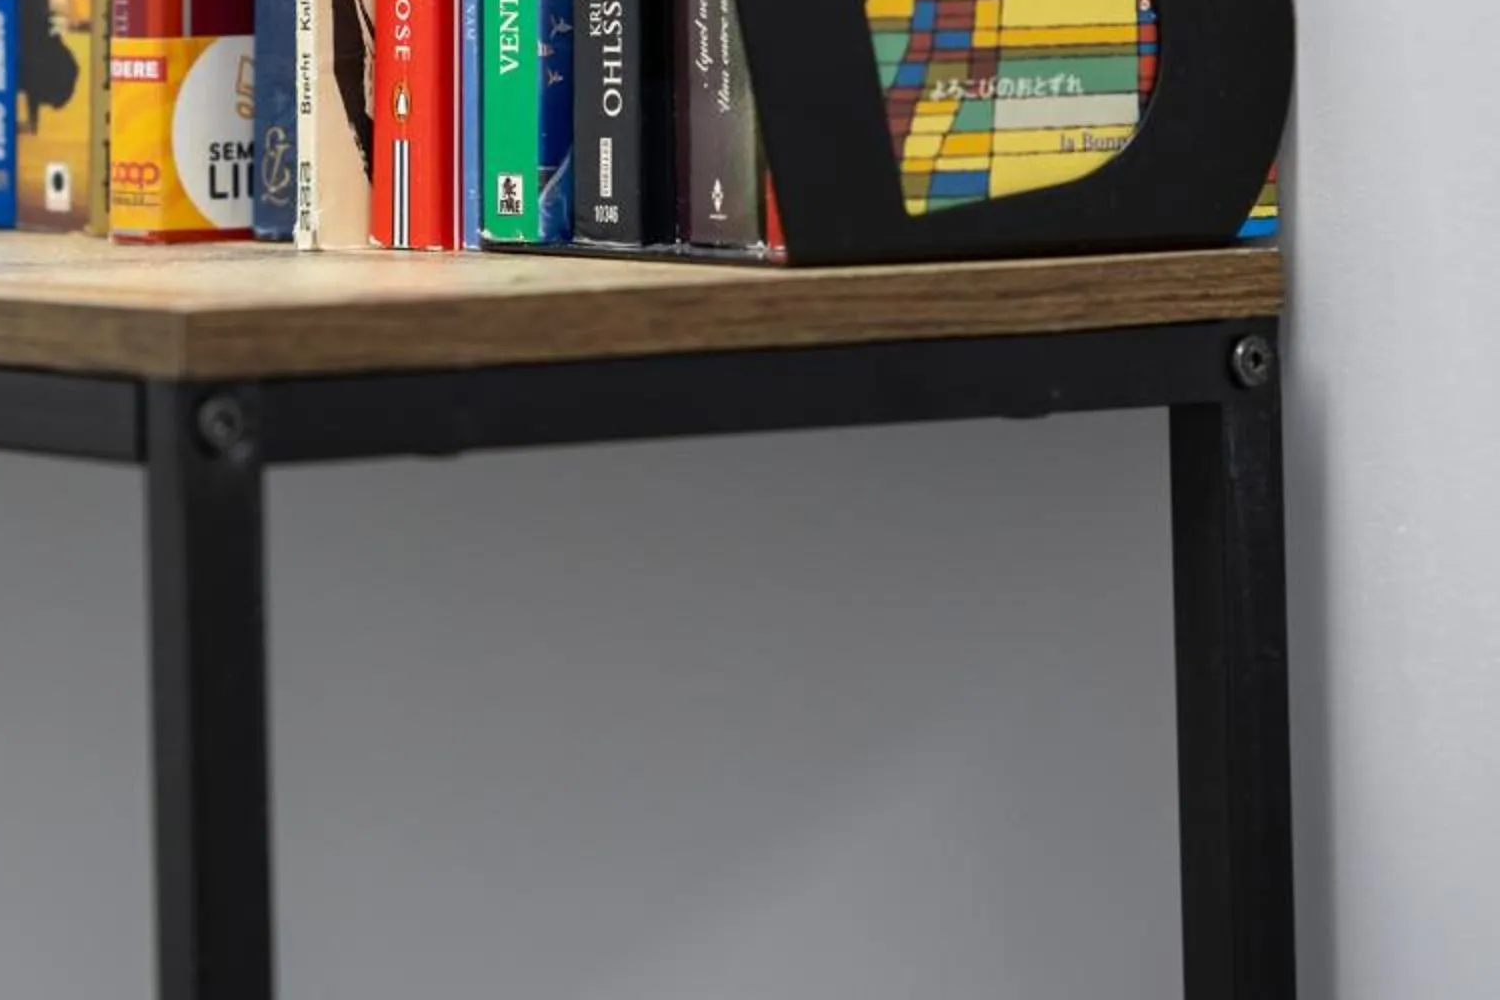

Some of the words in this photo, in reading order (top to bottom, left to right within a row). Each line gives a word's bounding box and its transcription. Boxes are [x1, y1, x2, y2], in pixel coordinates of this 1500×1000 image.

[301, 51, 312, 116] Brecht
[929, 73, 1084, 101] よろこびのおとずれ
[1060, 133, 1076, 153] la
[594, 204, 619, 223] 10346
